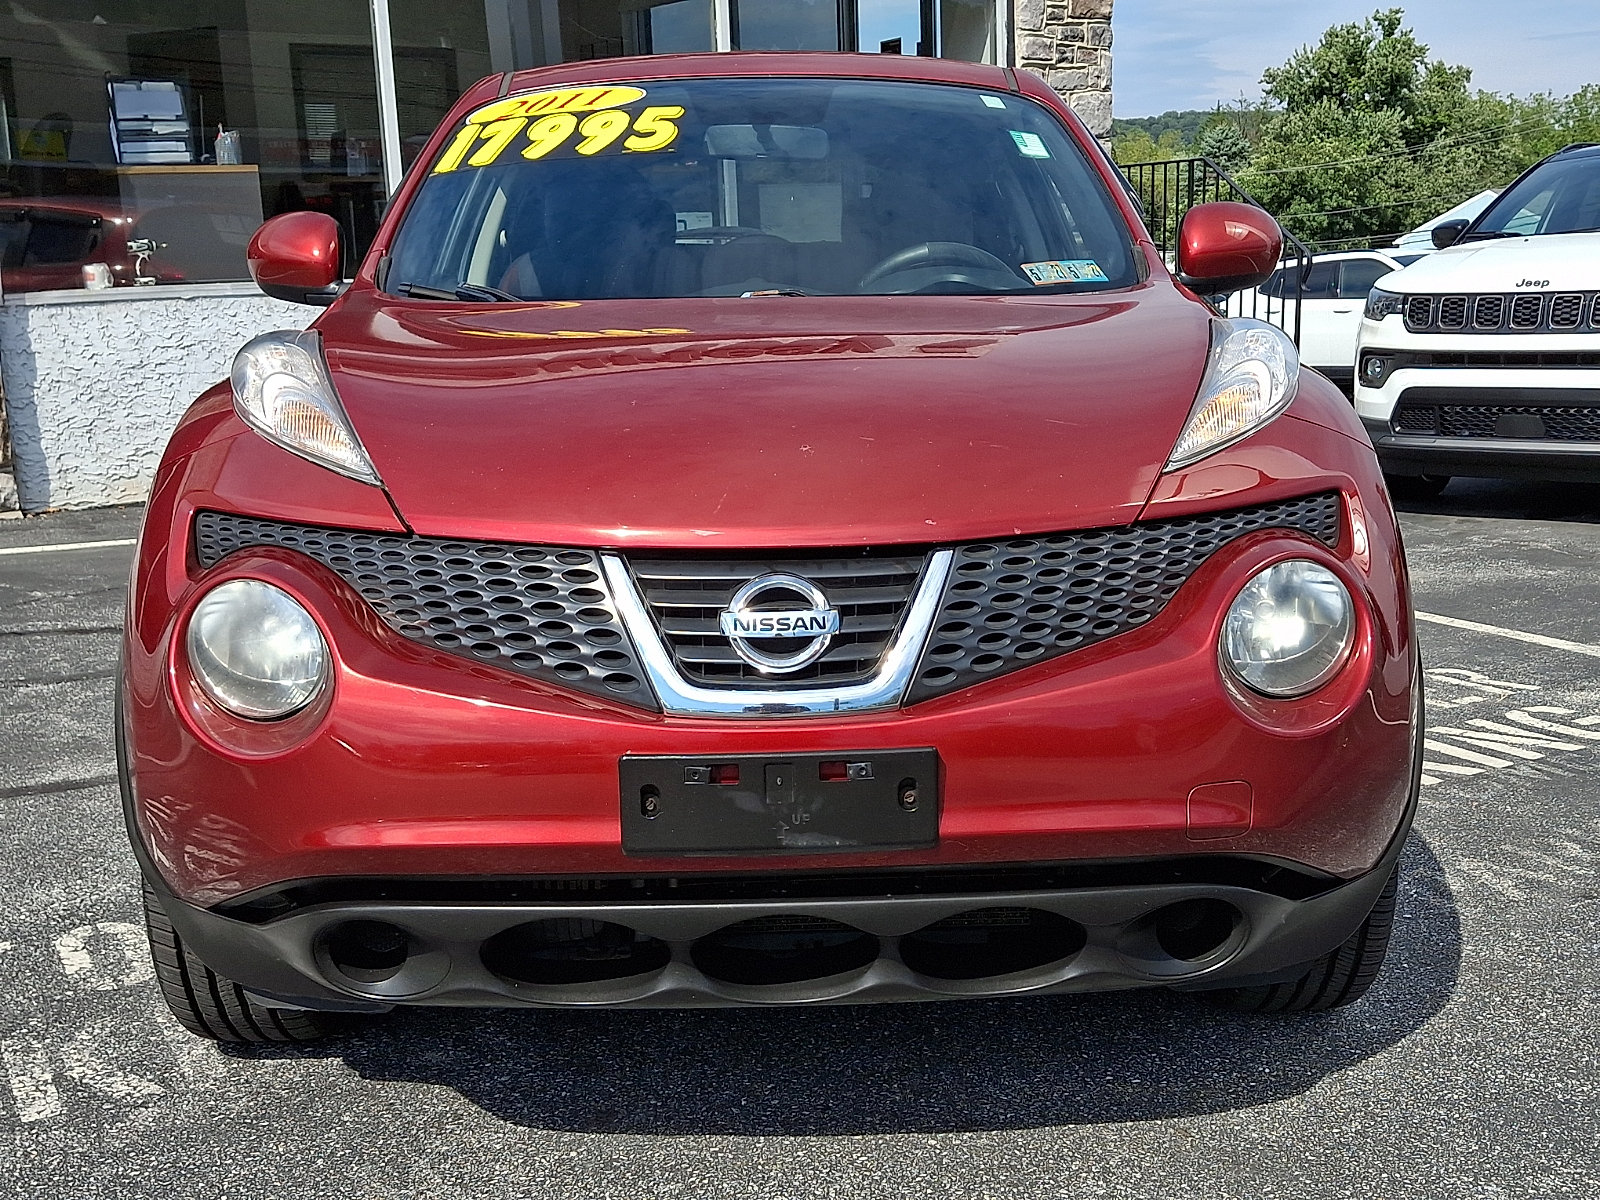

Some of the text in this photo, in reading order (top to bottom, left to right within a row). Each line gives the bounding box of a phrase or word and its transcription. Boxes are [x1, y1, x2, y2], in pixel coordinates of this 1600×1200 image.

[498, 89, 613, 121] 2011
[433, 106, 686, 173] 17995
[1515, 279, 1550, 289] Jeep
[733, 615, 828, 632] NISSAN
